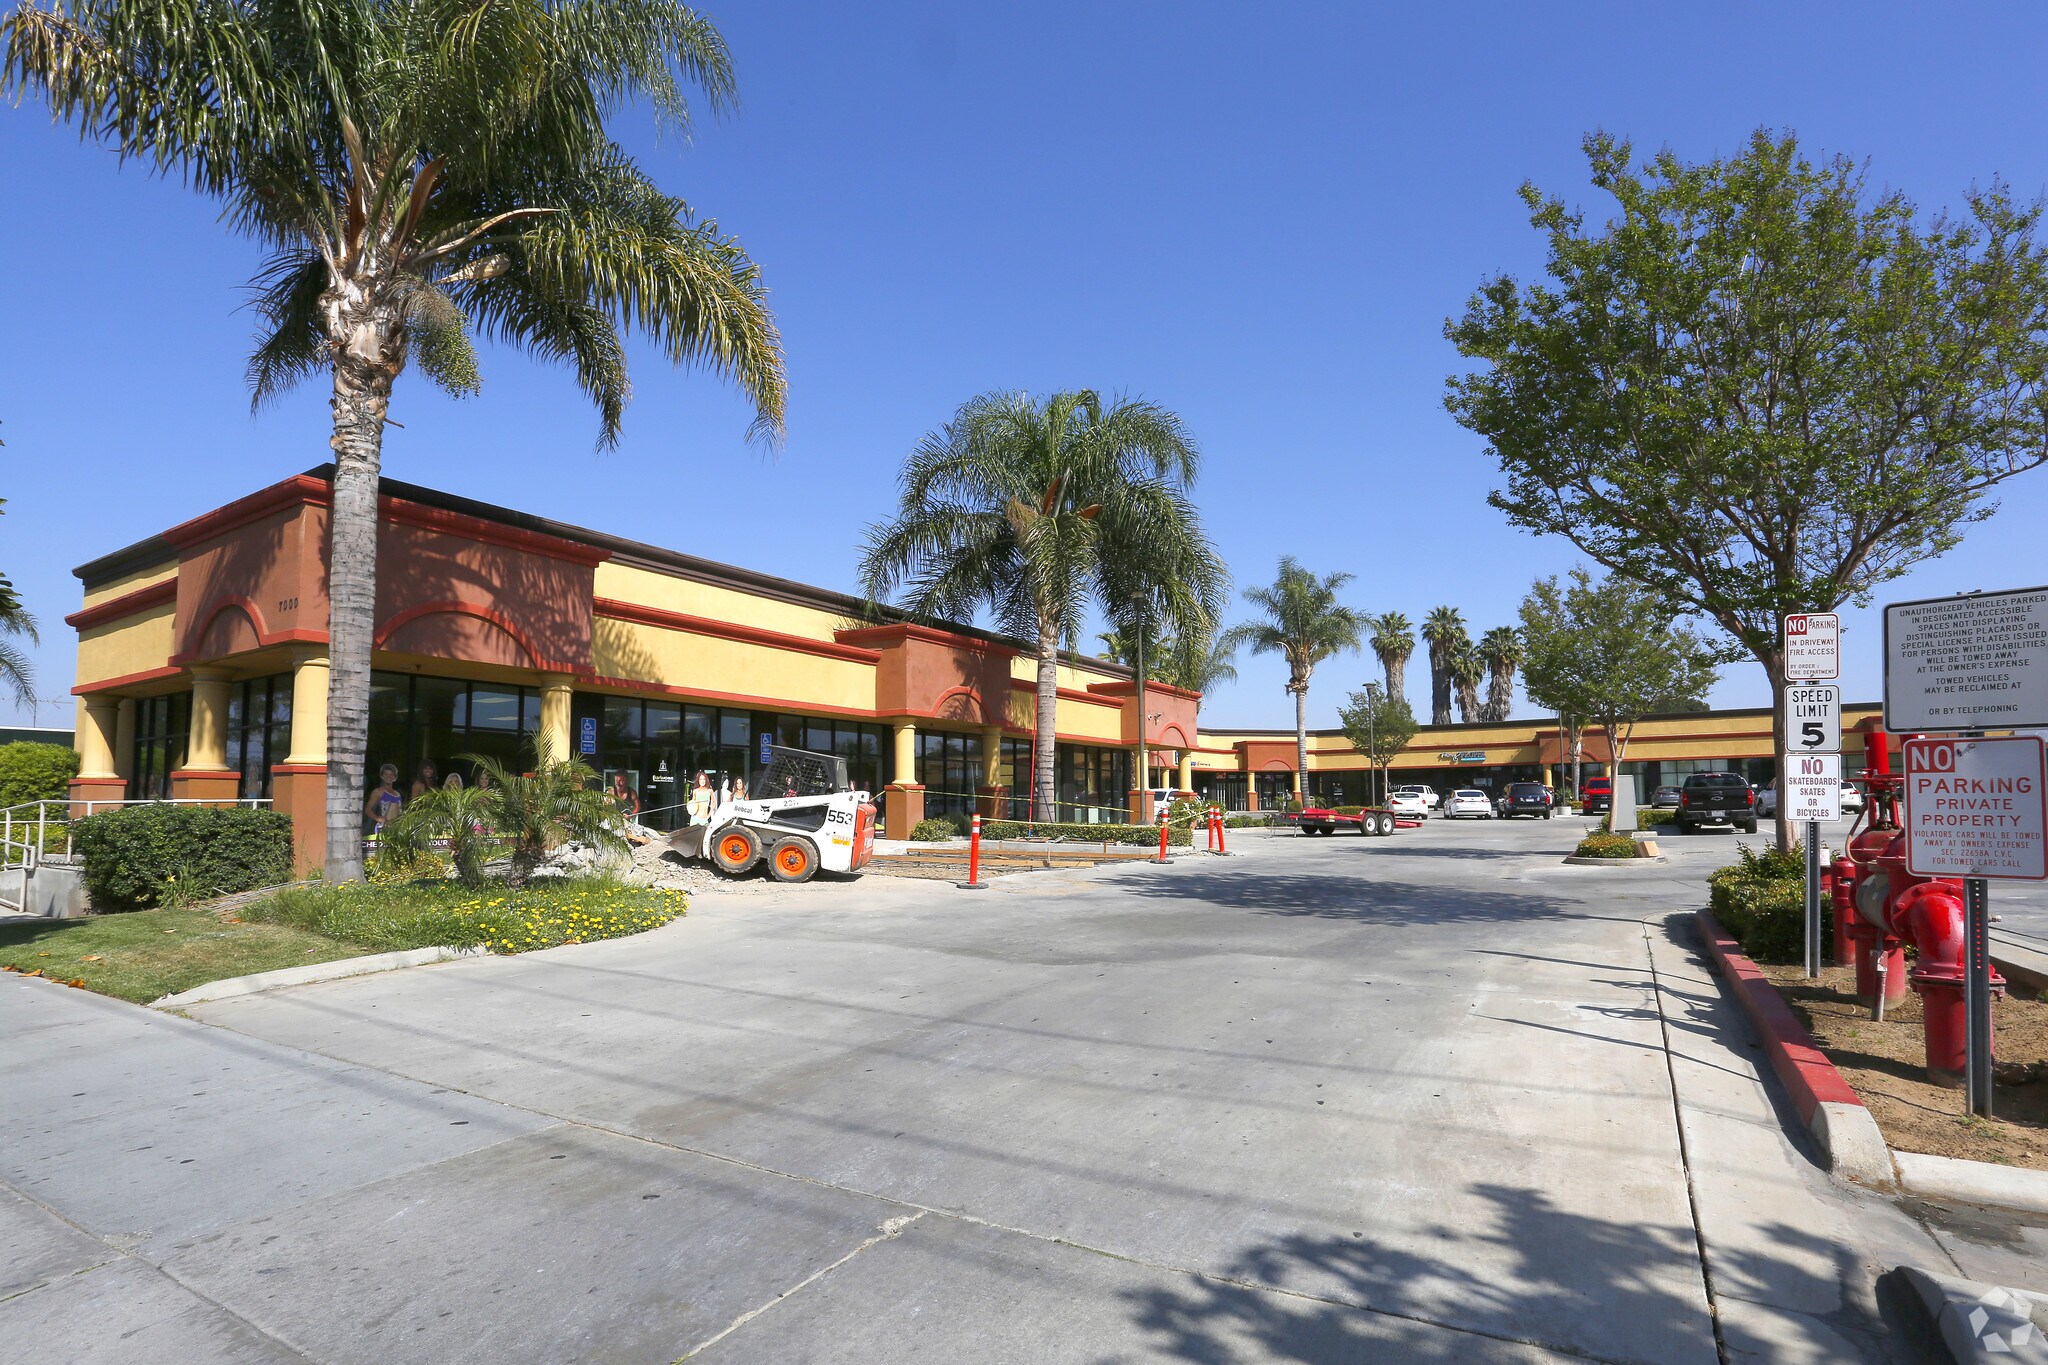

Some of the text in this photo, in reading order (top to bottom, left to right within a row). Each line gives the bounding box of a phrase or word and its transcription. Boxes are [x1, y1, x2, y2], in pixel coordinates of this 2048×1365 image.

[279, 597, 298, 612] 7000
[1900, 595, 2047, 617] UNAUTHORIZED VEHICLES PARKED
[1923, 612, 1974, 622] DESIGNATED
[1977, 605, 2032, 617] ACCESSIBLE
[1788, 620, 1835, 632] NO PARKING
[1918, 623, 1949, 631] SPACES
[1973, 615, 2026, 626] DISPLAYING
[1907, 630, 1973, 641] DISTINGUISHING
[1977, 624, 2023, 634] PLACARDS
[1901, 631, 2047, 649] SPECIAL LICENSE PLATES ISSUED
[1921, 647, 1959, 656] PERSONS
[1987, 640, 2045, 651] DISABILITIES
[1963, 653, 1991, 661] TOWED
[1995, 651, 2018, 659] AWAY
[1948, 663, 1984, 672] OWNER'S
[1989, 659, 2030, 668] EXPENSE
[1967, 674, 2009, 683] VEHICLES
[1959, 684, 2007, 692] RECLAIMED
[1793, 690, 1832, 702] SPEED
[1797, 705, 1828, 717] LIMIT
[1958, 705, 2018, 714] TELEPHONING
[1801, 722, 1825, 748] 5
[1911, 745, 1952, 771] NO
[1802, 759, 1823, 774] NO
[1918, 777, 2031, 794] PARKING
[734, 805, 753, 814] Bobcat
[1936, 798, 2012, 810] PRIVATE
[828, 810, 853, 825] 553
[1797, 809, 1829, 817] BICYCLES
[1923, 815, 2021, 826] PROPERTY
